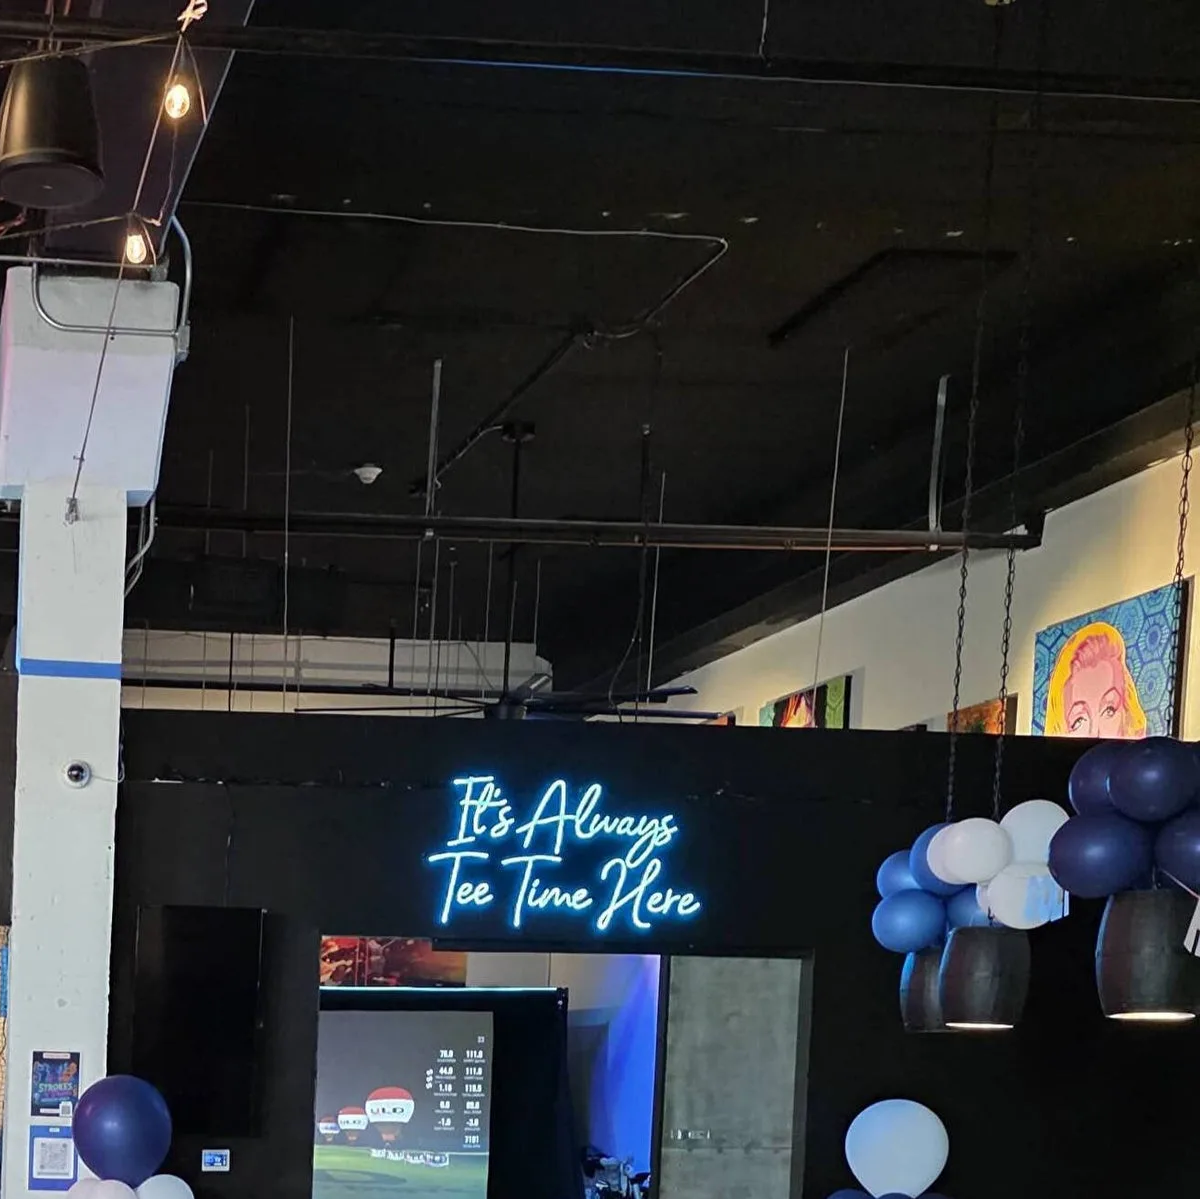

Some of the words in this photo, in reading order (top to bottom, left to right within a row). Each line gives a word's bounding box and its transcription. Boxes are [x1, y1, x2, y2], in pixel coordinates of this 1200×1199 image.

[447, 776, 515, 847] It's
[516, 779, 678, 869] Always
[428, 851, 494, 925] Tee
[501, 853, 593, 928] Time
[600, 857, 701, 931] Here
